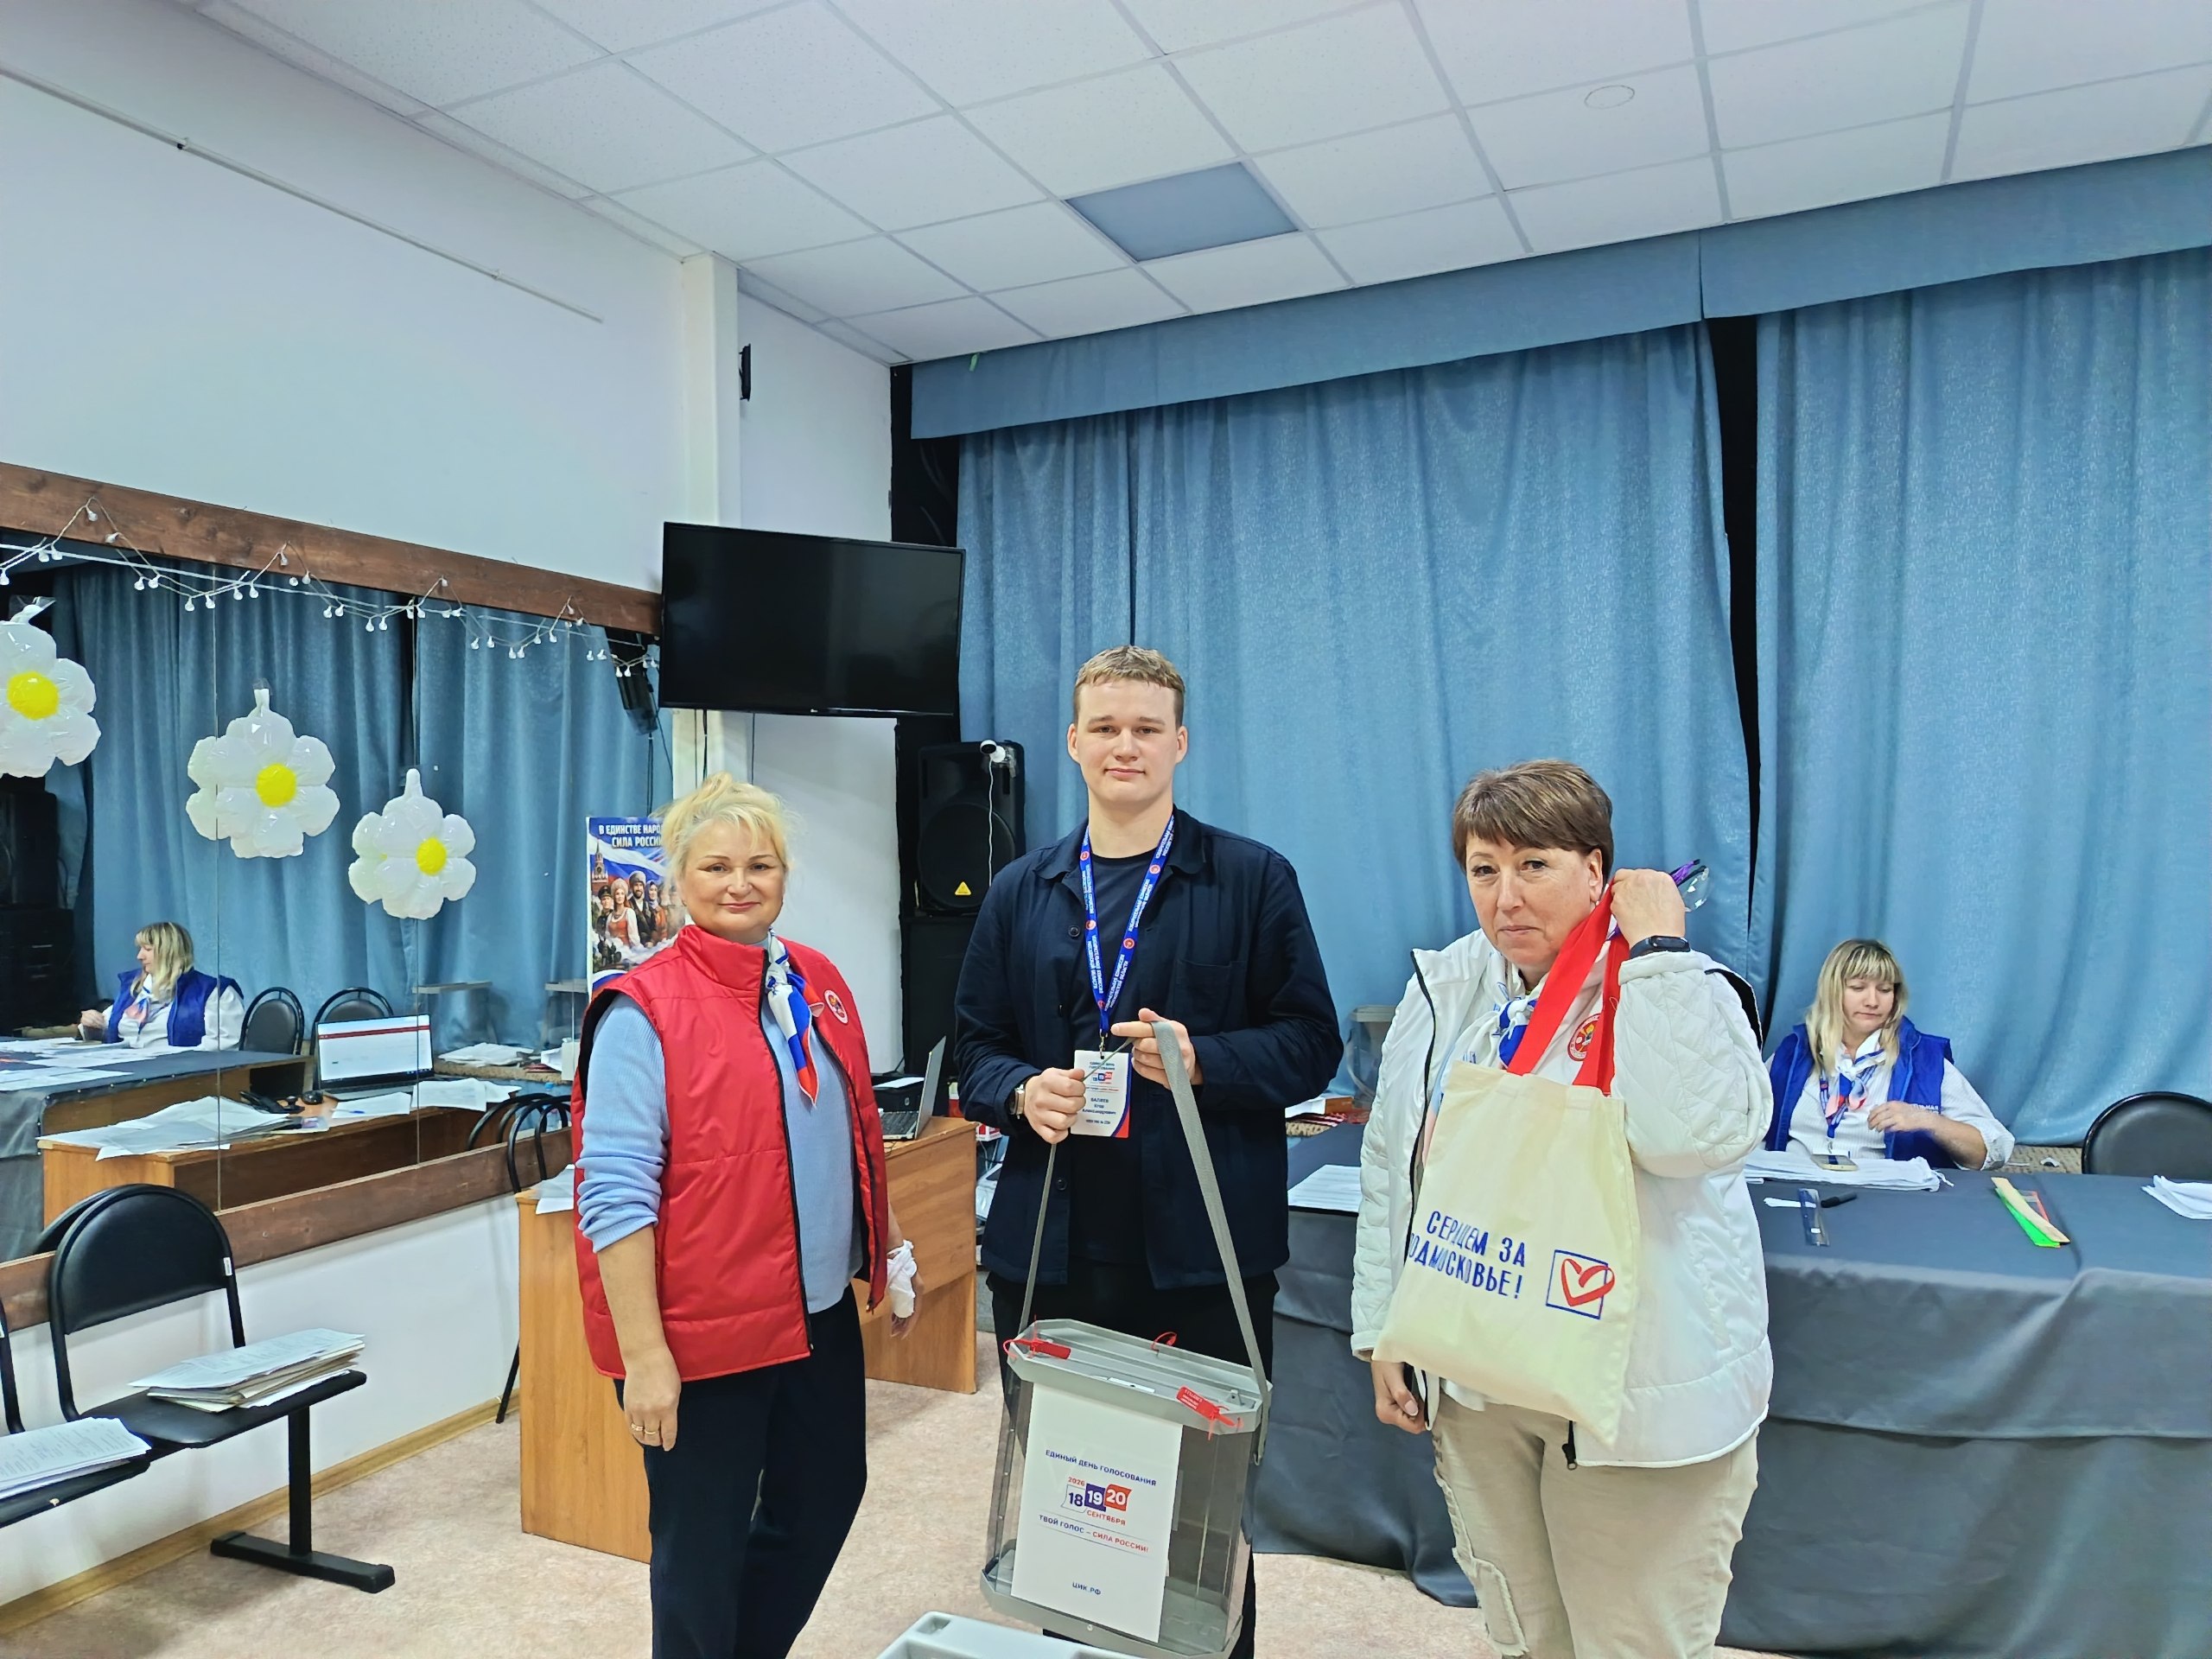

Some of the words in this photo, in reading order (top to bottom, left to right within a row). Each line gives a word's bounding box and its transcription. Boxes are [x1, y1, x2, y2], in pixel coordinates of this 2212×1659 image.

[599, 824, 605, 835] В
[606, 824, 642, 836] ЕДИНСТВЕ
[643, 823, 663, 834] НАРО
[612, 836, 633, 847] СИЛА
[1498, 1236, 1526, 1268] ЗА
[1046, 1449, 1077, 1464] ЕДИНЫЙ
[1078, 1459, 1098, 1470] ДЕНЬ
[1100, 1465, 1157, 1486] ГОЛОСОВАНИЯ
[1068, 1476, 1085, 1486] 2026
[1068, 1491, 1084, 1507] 18
[1087, 1490, 1103, 1505] 19
[1106, 1488, 1126, 1506] 20
[1086, 1510, 1126, 1527] СЕНТЯБРЯ
[1039, 1514, 1058, 1527] ТВОЙ
[1059, 1521, 1084, 1534] ГОЛОС
[1092, 1530, 1114, 1542] СИЛА
[1115, 1537, 1149, 1554] РОССИИ!
